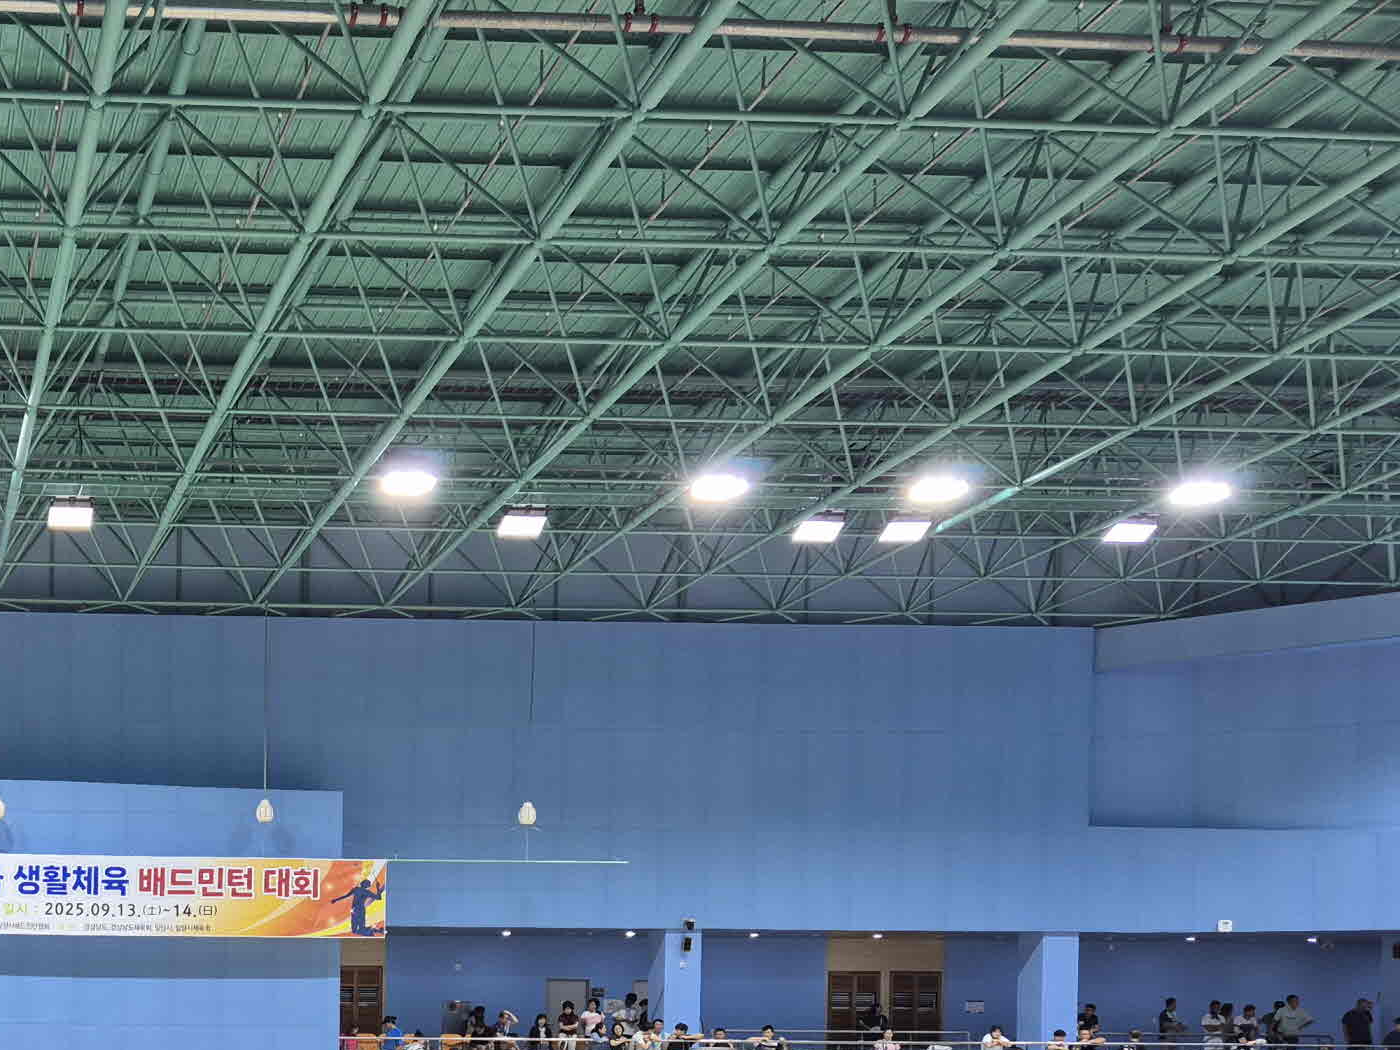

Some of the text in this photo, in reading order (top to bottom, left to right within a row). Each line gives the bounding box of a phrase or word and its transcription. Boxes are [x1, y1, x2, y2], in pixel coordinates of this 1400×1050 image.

[14, 865, 130, 896] 생활체육
[139, 867, 253, 897] 배드민턴
[264, 868, 319, 898] 대회
